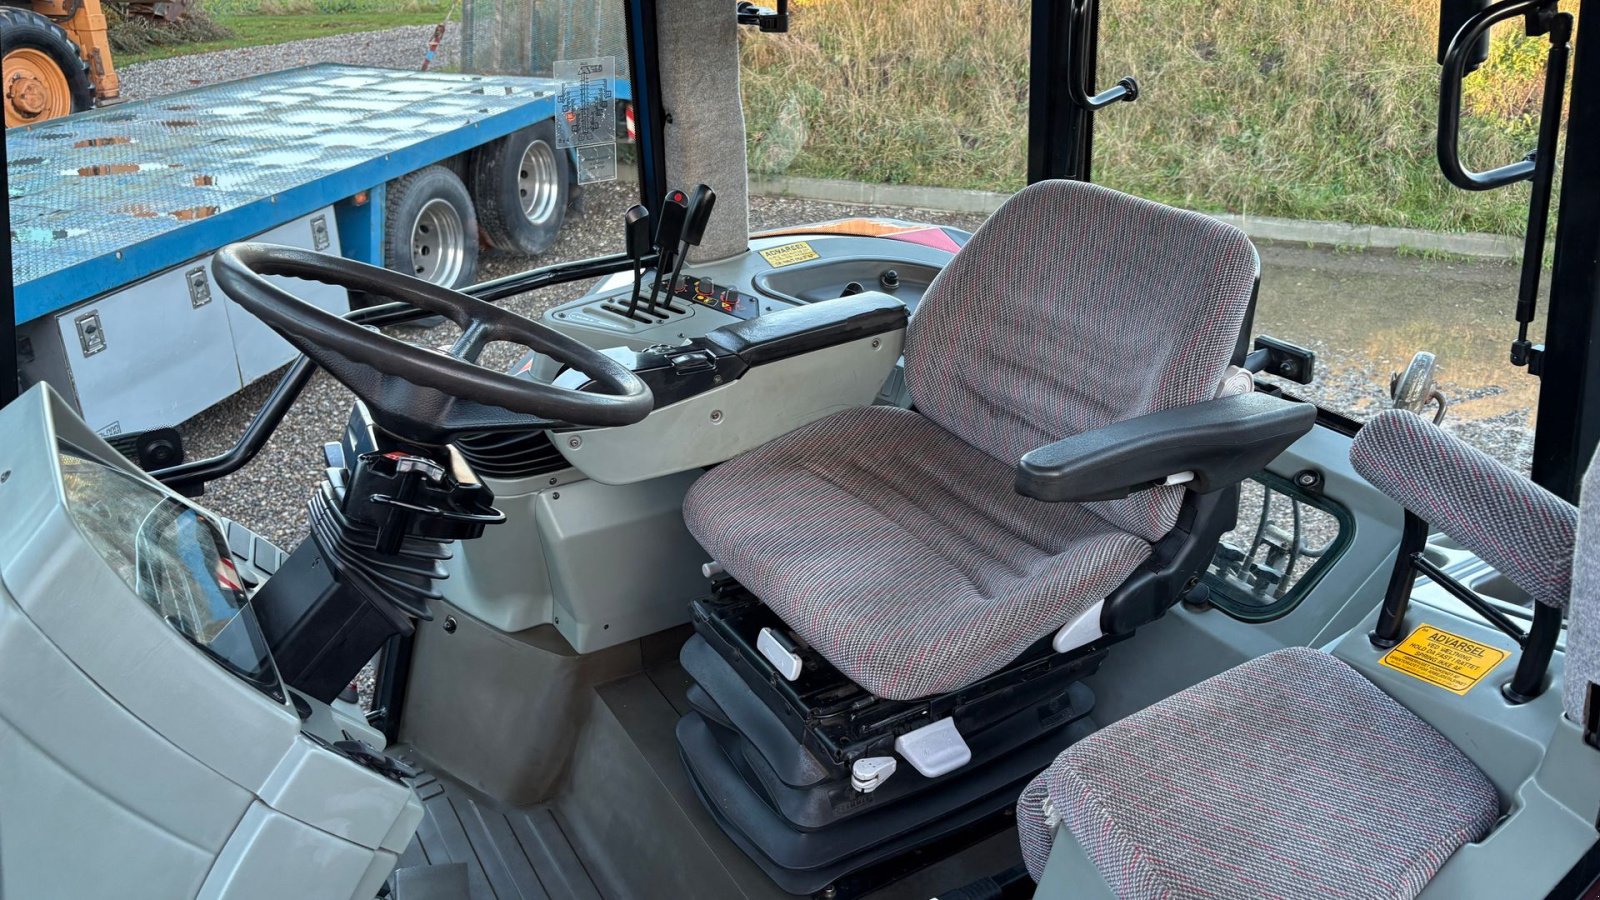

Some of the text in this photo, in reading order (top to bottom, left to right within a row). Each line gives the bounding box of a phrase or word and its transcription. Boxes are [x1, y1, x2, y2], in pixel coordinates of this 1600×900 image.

[1409, 642, 1427, 651] HOLD
[1434, 652, 1452, 660] FAST
[1454, 659, 1480, 670] RATTET
[1428, 632, 1487, 657] ADVARSEL
[1414, 651, 1438, 662] SPRING
[1436, 659, 1453, 667] IKKE
